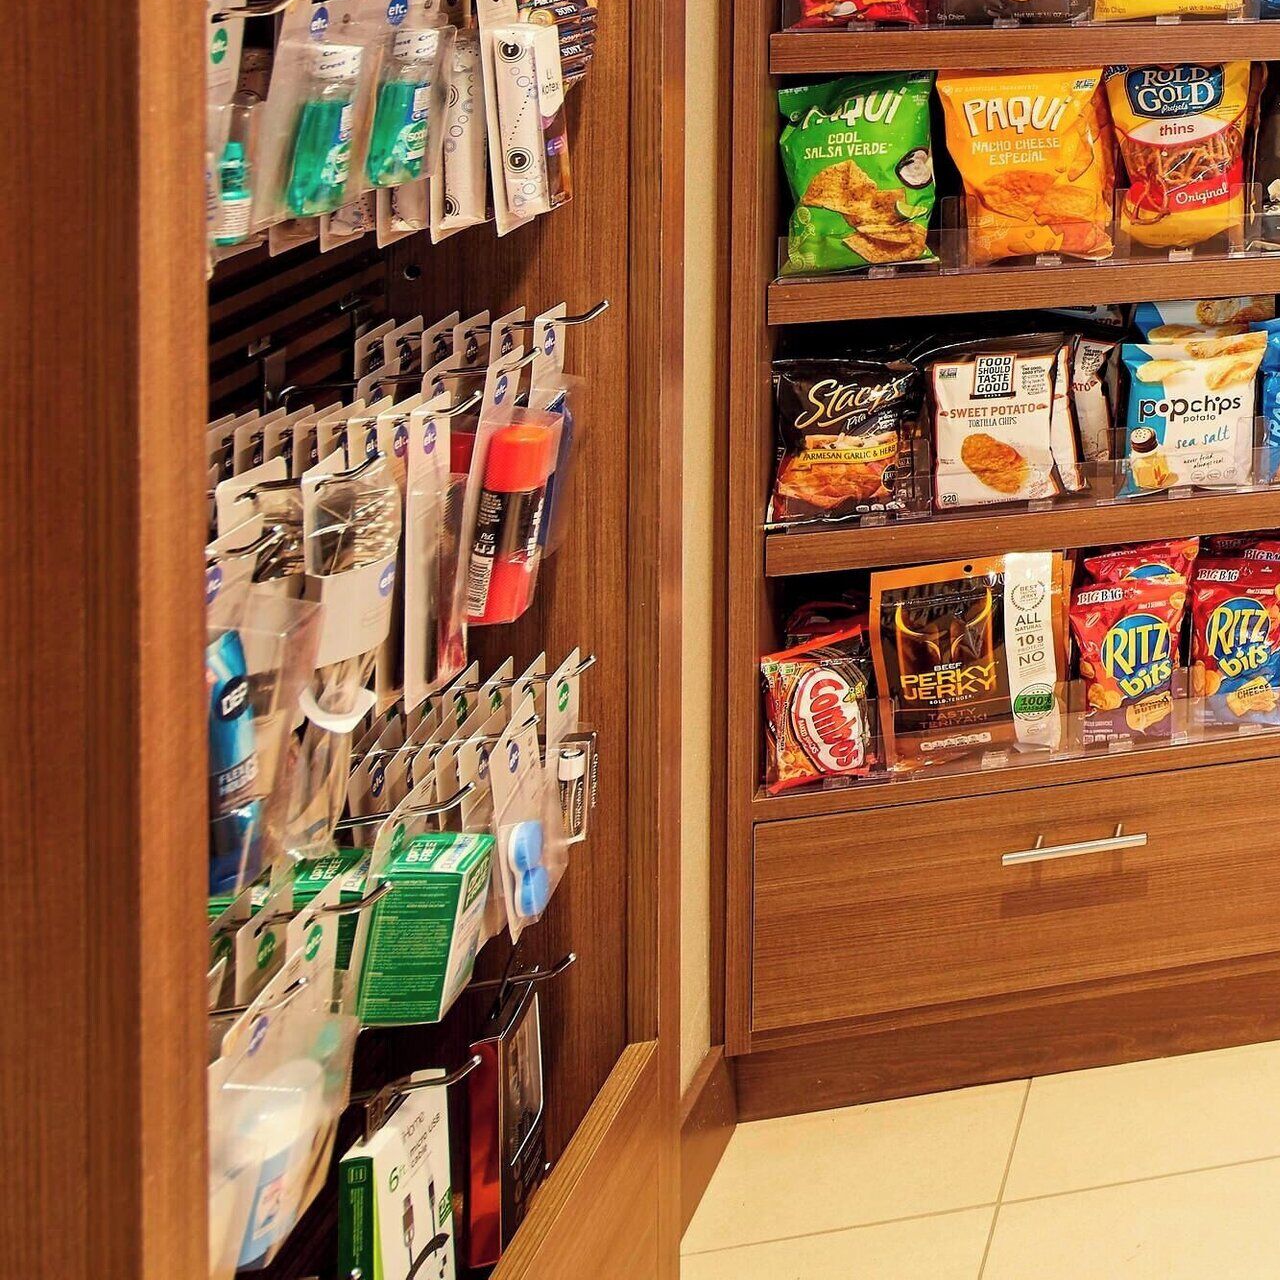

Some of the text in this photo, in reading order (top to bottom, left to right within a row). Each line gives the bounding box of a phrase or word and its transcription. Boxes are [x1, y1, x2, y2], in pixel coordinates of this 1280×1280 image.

[1138, 81, 1215, 112] GOLD
[1160, 122, 1196, 136] thins
[828, 133, 862, 144] COOL
[972, 137, 1060, 153] NACHO CHEESE
[804, 143, 888, 158] SALSA VERDE
[1176, 184, 1228, 204] Original
[979, 358, 1011, 367] FOOD
[978, 367, 1010, 375] SHOULD
[978, 374, 1009, 383] TASTE
[977, 383, 1009, 392] GOOD
[795, 378, 904, 429] Stacy's
[950, 403, 1036, 419] SWEET POTATO
[1139, 395, 1242, 422] popchips
[968, 417, 1018, 428] TORTILLA CHIPS
[1183, 413, 1216, 423] potato
[1175, 426, 1230, 449] sea salt
[844, 452, 871, 460] GARLIC
[880, 445, 896, 455] HERB
[1198, 569, 1239, 581] BIG BAG
[1077, 588, 1123, 605] BIG BAG
[1015, 613, 1042, 626] ALL
[1015, 624, 1042, 632] NATURAL
[1207, 607, 1269, 656] RITZ
[1017, 635, 1034, 646] 10
[1104, 622, 1170, 677] RITZ
[934, 662, 962, 671] BEEF
[1019, 652, 1044, 666] NO
[1219, 644, 1268, 678] bits
[900, 662, 996, 688] PERKY
[1119, 660, 1172, 698] bits
[904, 675, 997, 700] JERKY
[1237, 683, 1271, 698] CHEESE
[809, 675, 859, 770] Combos
